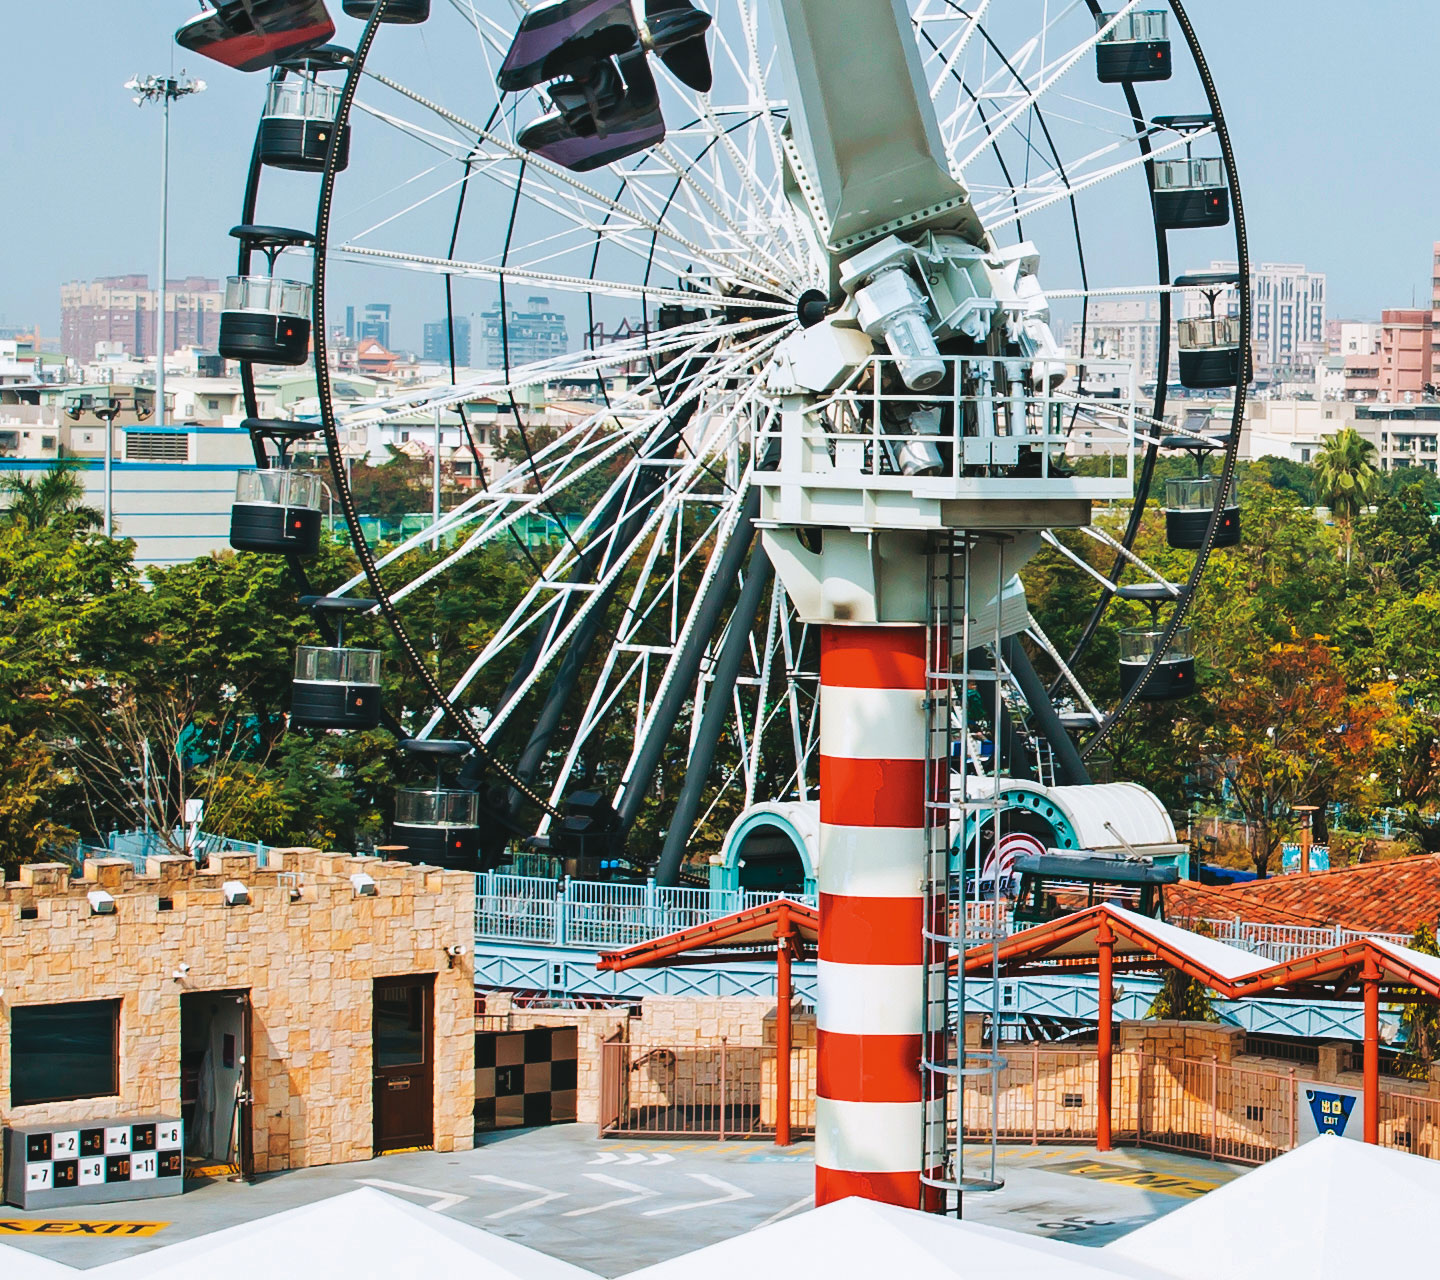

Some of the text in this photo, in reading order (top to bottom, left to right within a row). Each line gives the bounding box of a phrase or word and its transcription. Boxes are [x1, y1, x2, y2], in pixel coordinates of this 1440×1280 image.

[94, 1135, 100, 1148] 3
[120, 1133, 127, 1145] 4
[145, 1131, 152, 1144] 5
[171, 1129, 177, 1141] 6
[43, 1139, 48, 1153] 1
[68, 1138, 74, 1150] 2
[118, 1161, 130, 1175] 10
[144, 1159, 154, 1172] 11
[170, 1156, 180, 1170] 12
[42, 1170, 48, 1182] 7
[67, 1167, 74, 1180] 8
[94, 1164, 100, 1176] 9
[33, 1223, 157, 1234] EXIT
